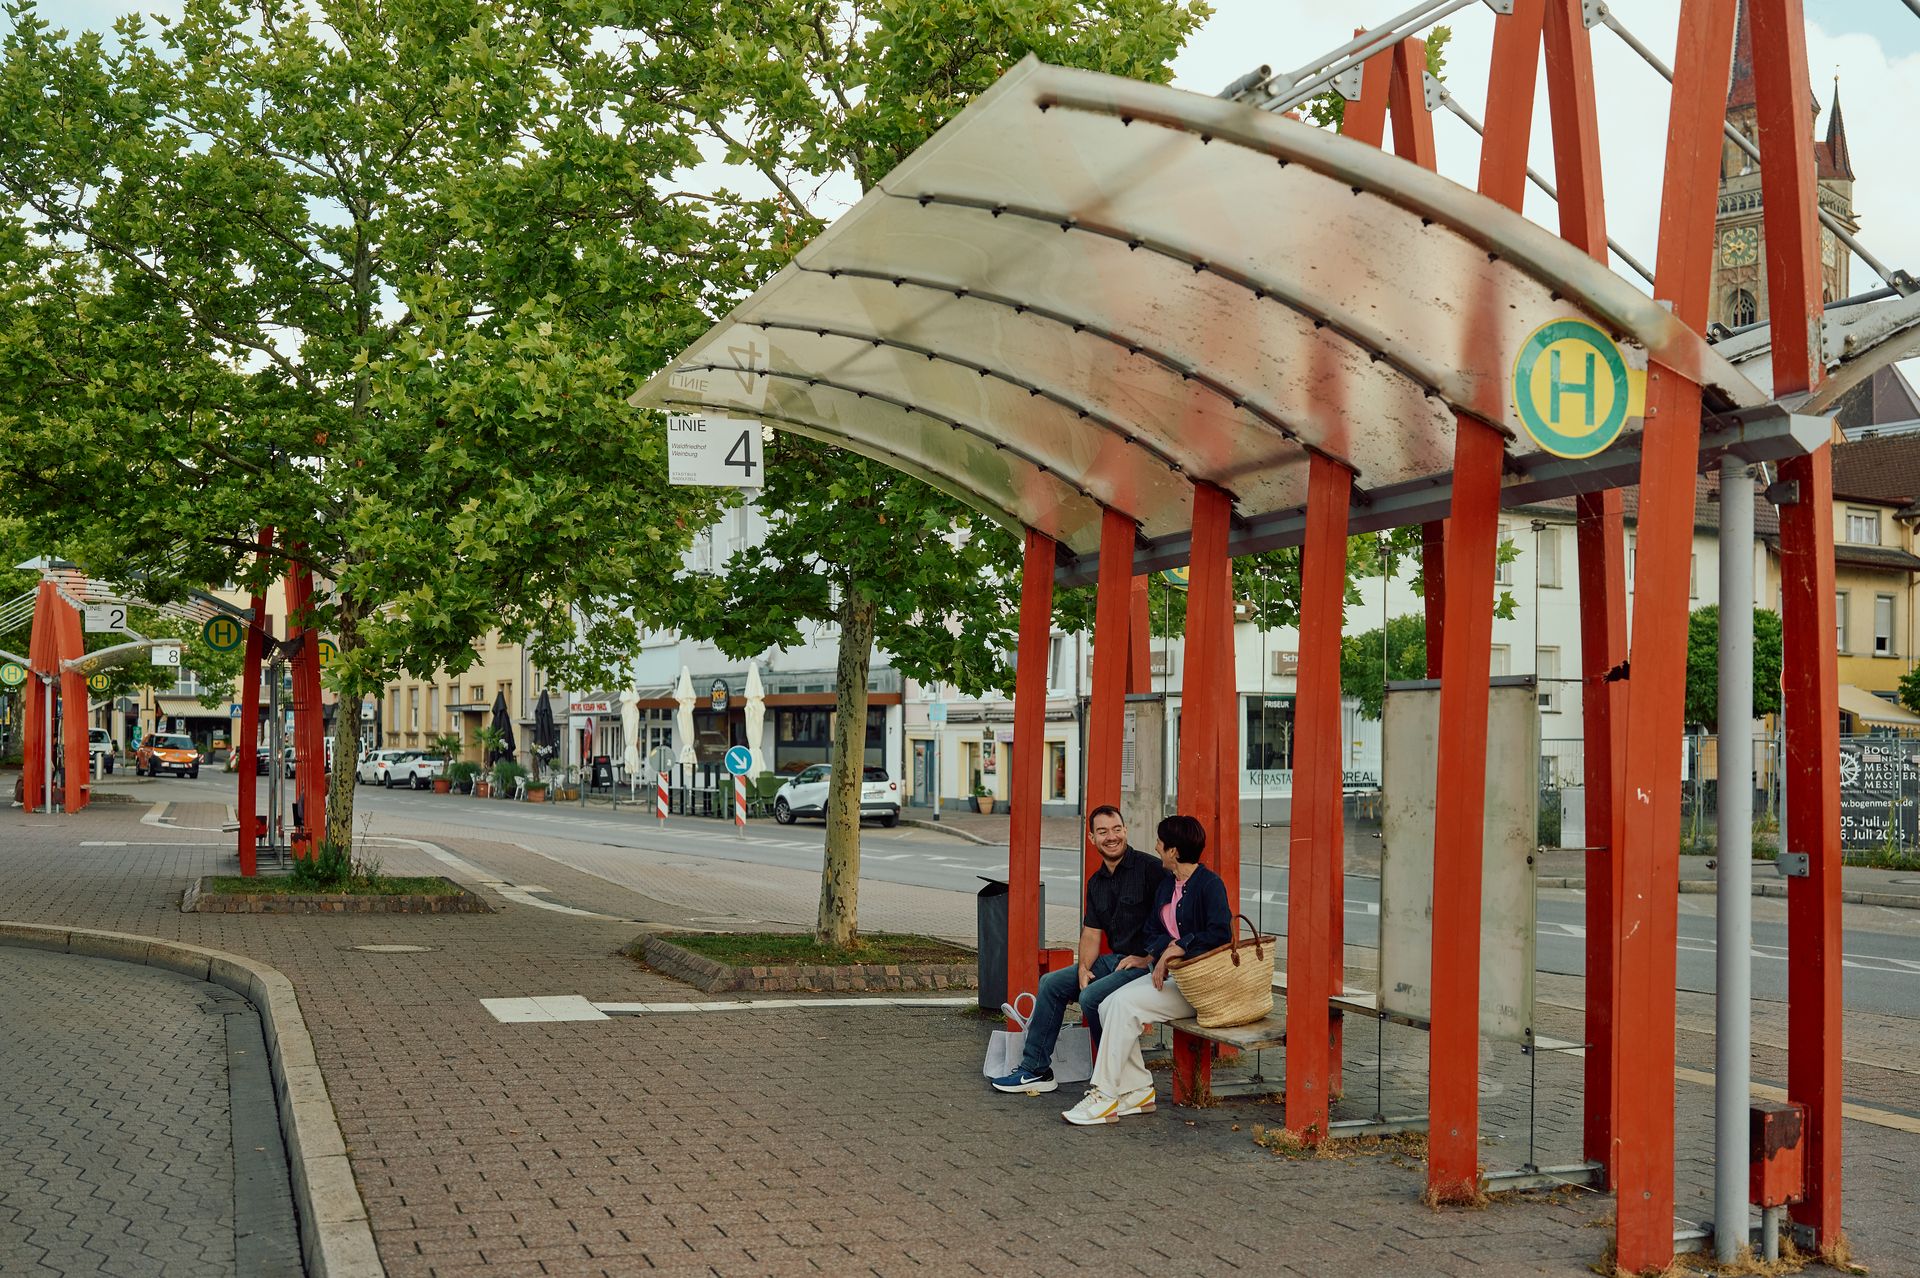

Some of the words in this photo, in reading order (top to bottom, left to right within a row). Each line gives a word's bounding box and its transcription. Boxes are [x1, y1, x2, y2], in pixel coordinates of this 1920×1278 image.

[1550, 350, 1595, 426] H
[669, 418, 707, 432] LINIE
[671, 443, 707, 451] Waldfriedhof
[724, 429, 757, 477] 4
[671, 450, 698, 458] Weinburg
[110, 609, 124, 629] 2
[215, 623, 232, 644] H
[168, 649, 178, 664] 8
[7, 667, 17, 680] H
[95, 676, 104, 687] H
[1264, 700, 1290, 709] FRISEUR
[1860, 815, 1880, 827] Juli
[1852, 829, 1872, 840] Juli
